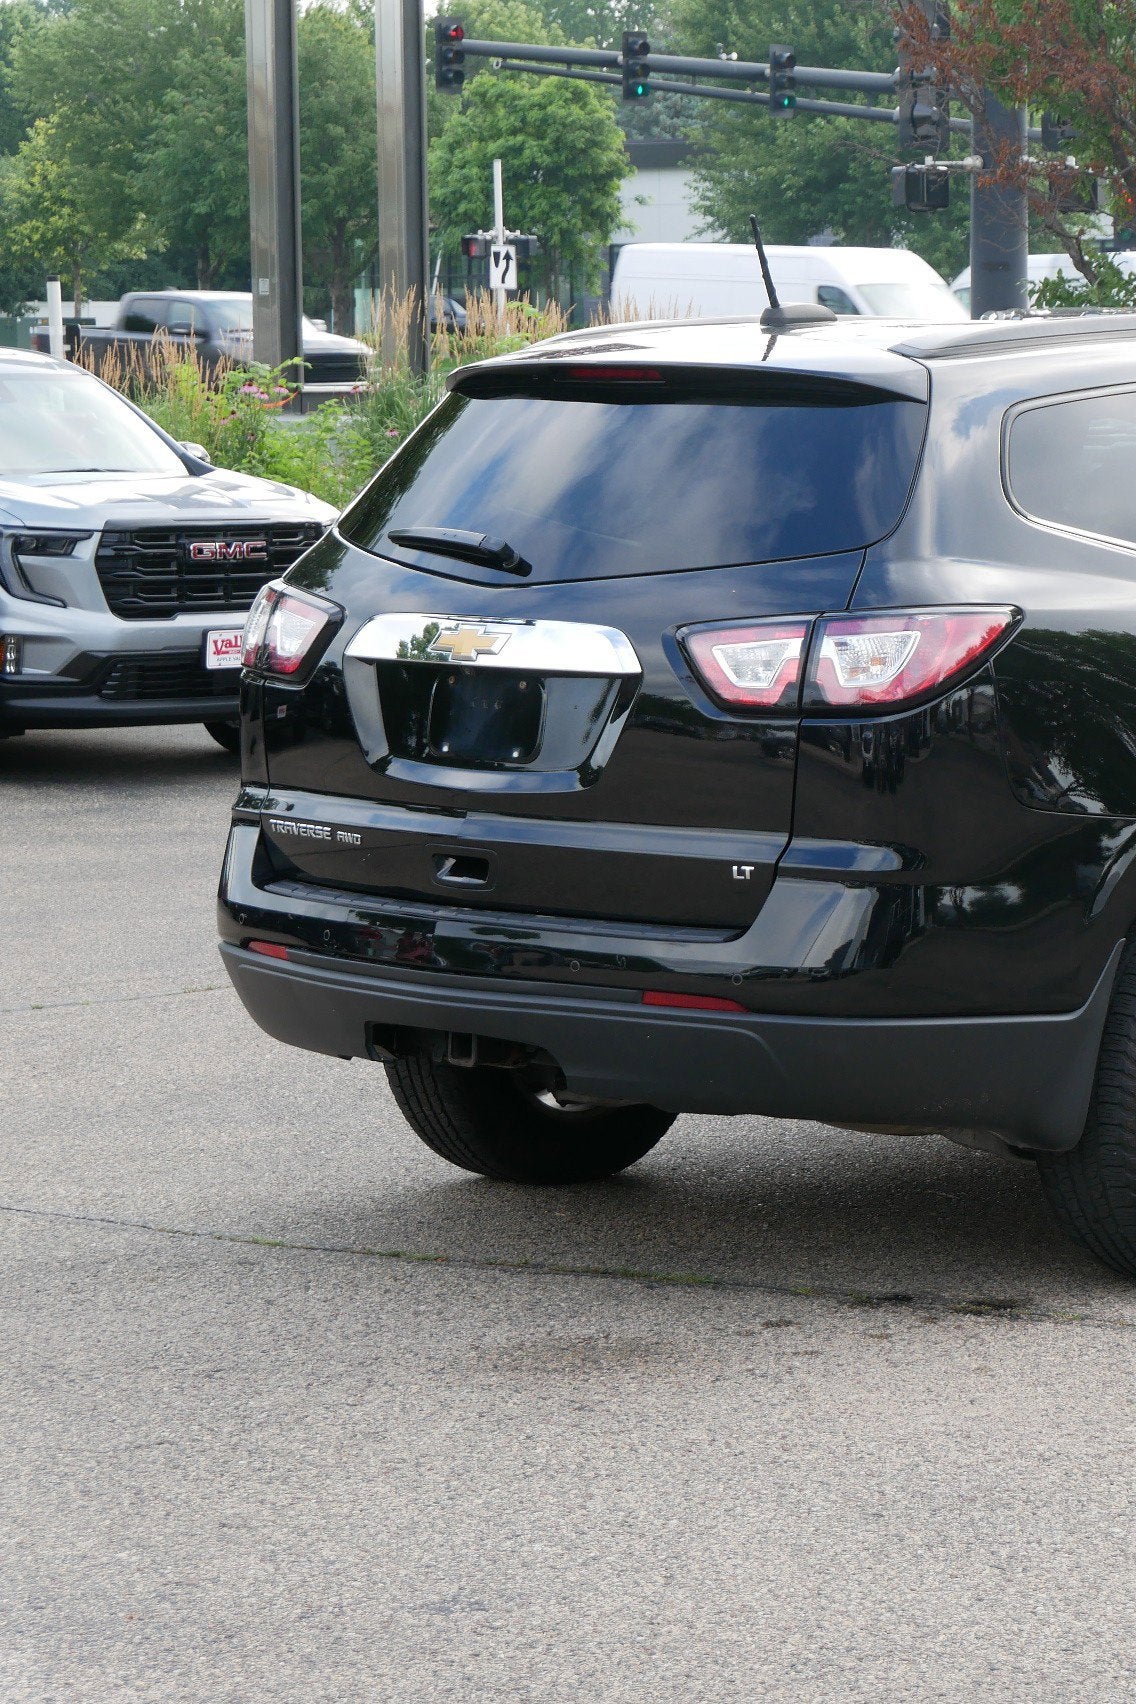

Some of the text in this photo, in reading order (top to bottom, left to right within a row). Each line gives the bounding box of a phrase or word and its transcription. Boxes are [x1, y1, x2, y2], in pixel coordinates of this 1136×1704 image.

[189, 540, 268, 561] GMC
[269, 818, 362, 845] TRAVERSE AWD
[732, 865, 755, 880] LT
